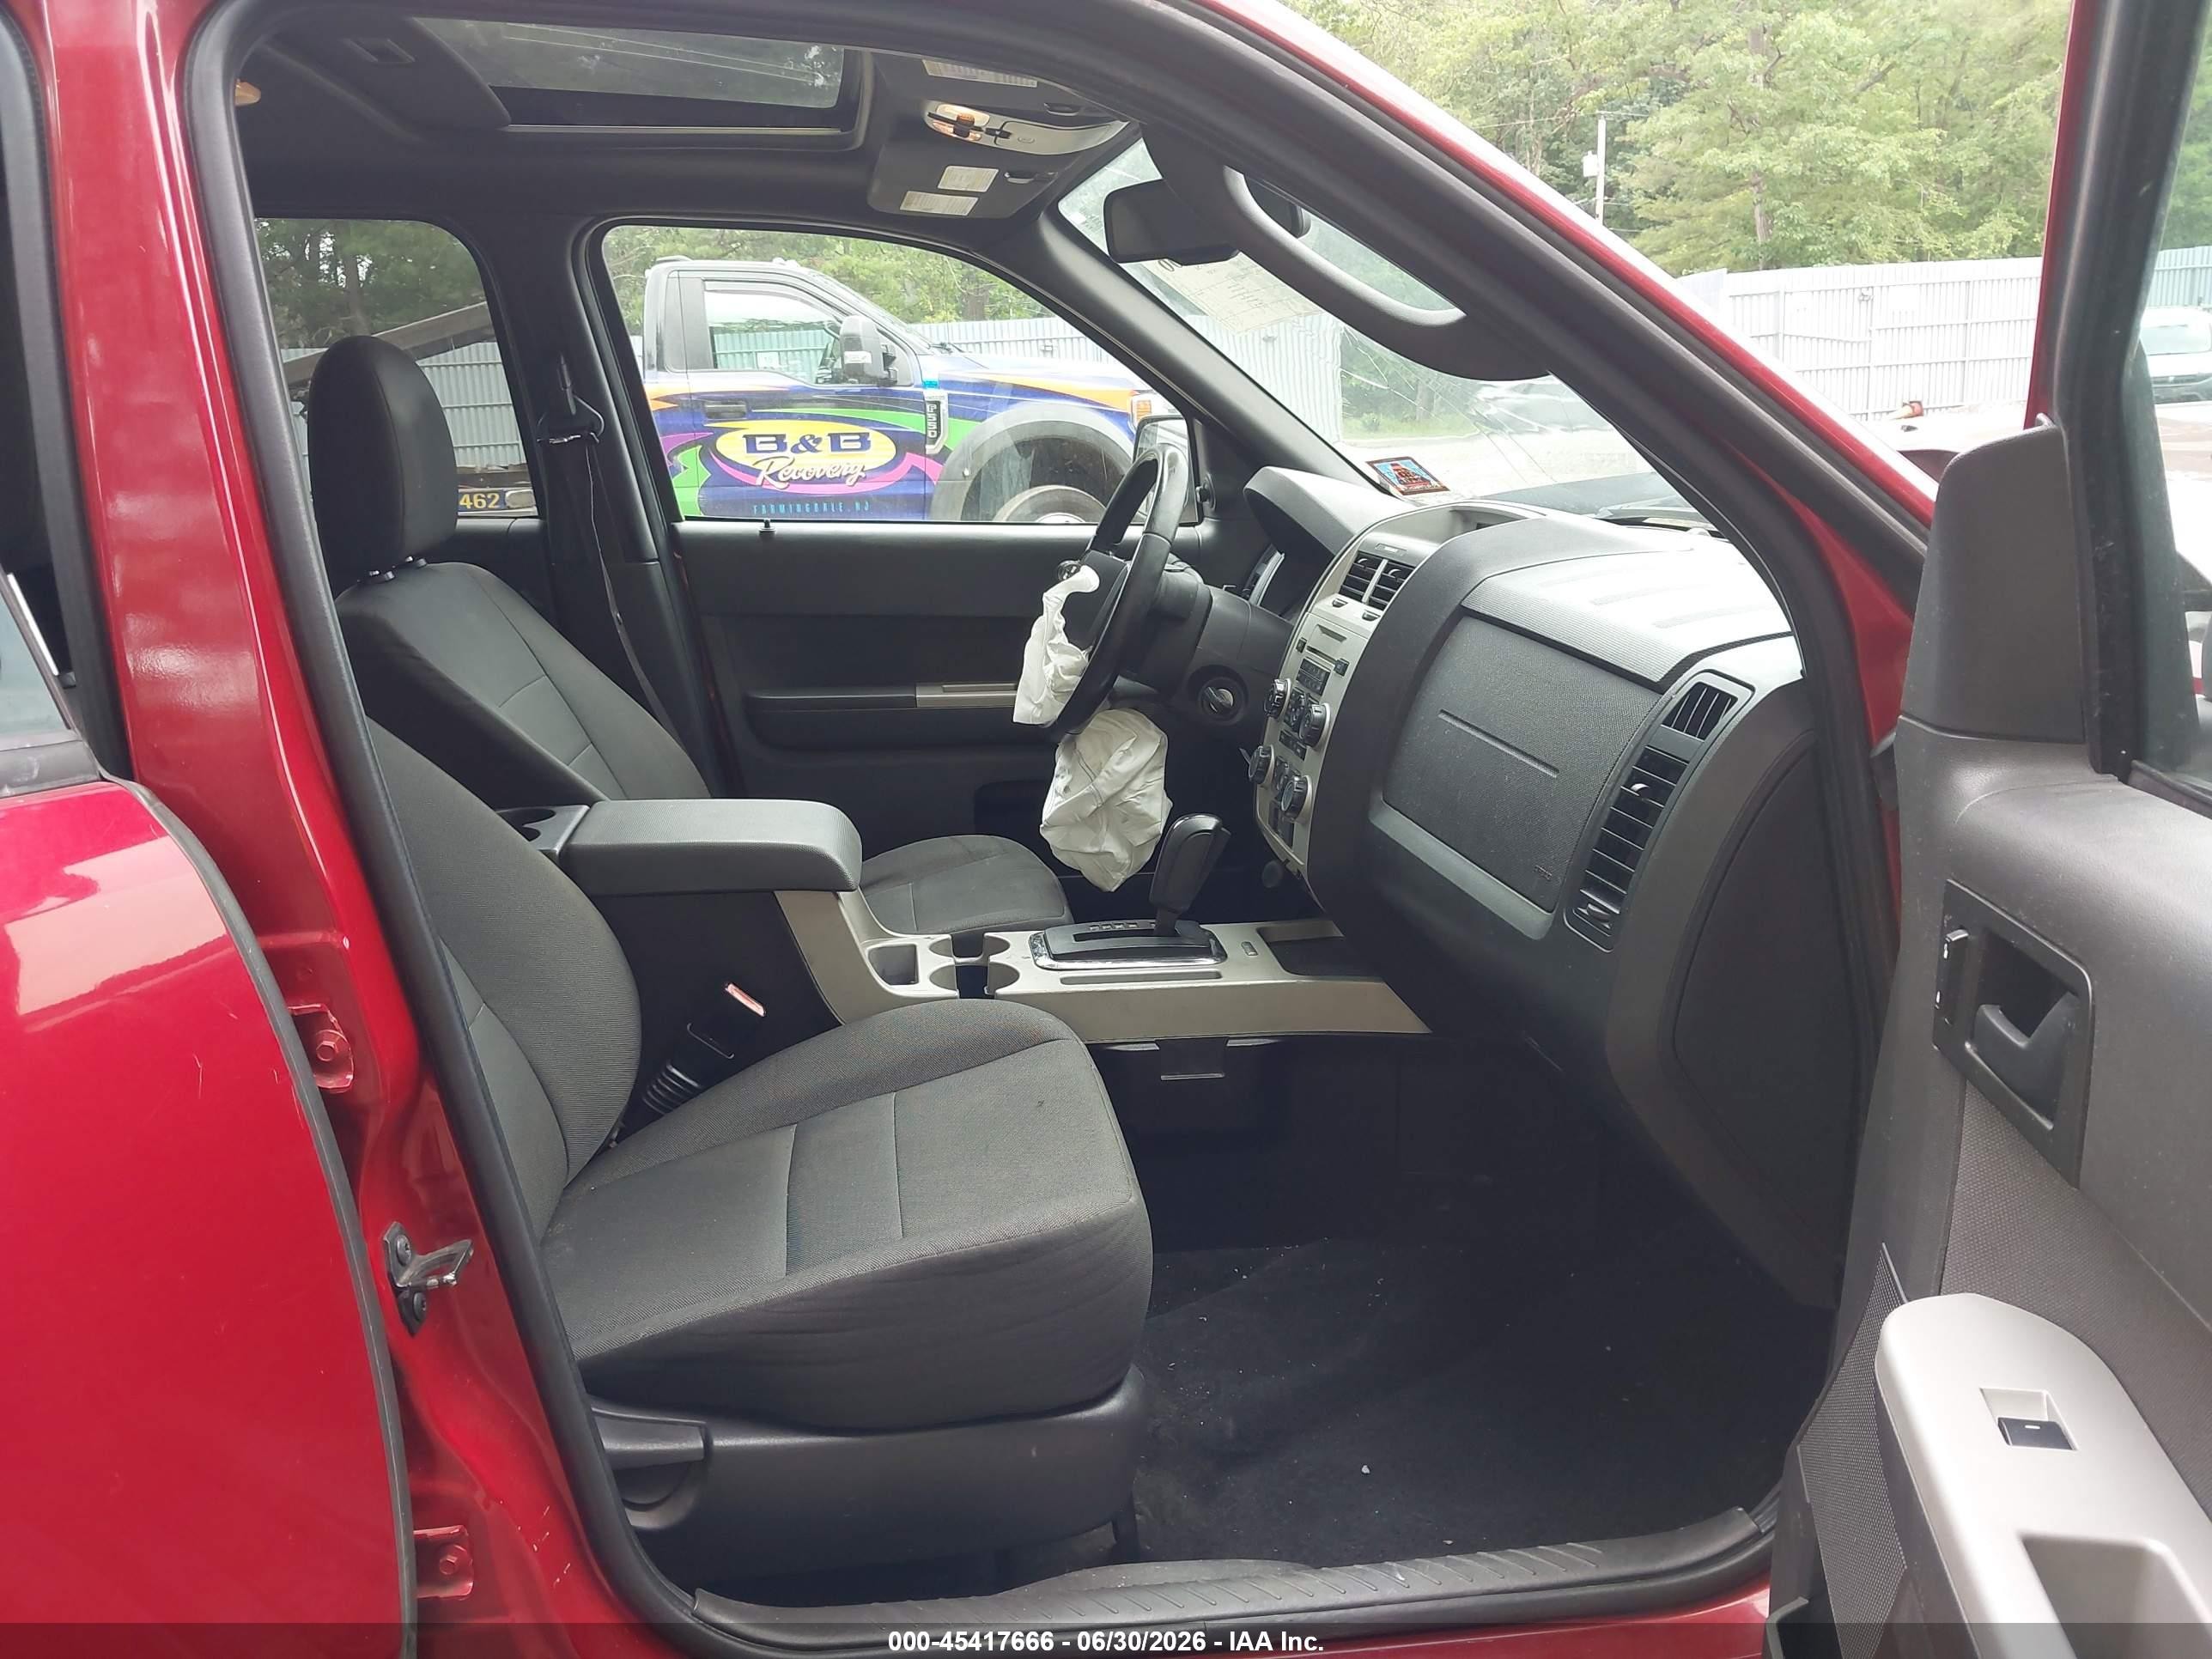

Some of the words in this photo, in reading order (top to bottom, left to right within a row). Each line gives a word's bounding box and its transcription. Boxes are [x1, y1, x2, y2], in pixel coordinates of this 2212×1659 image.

[743, 432, 872, 454] B&B
[752, 456, 866, 489] Recovery
[459, 493, 500, 509] 462
